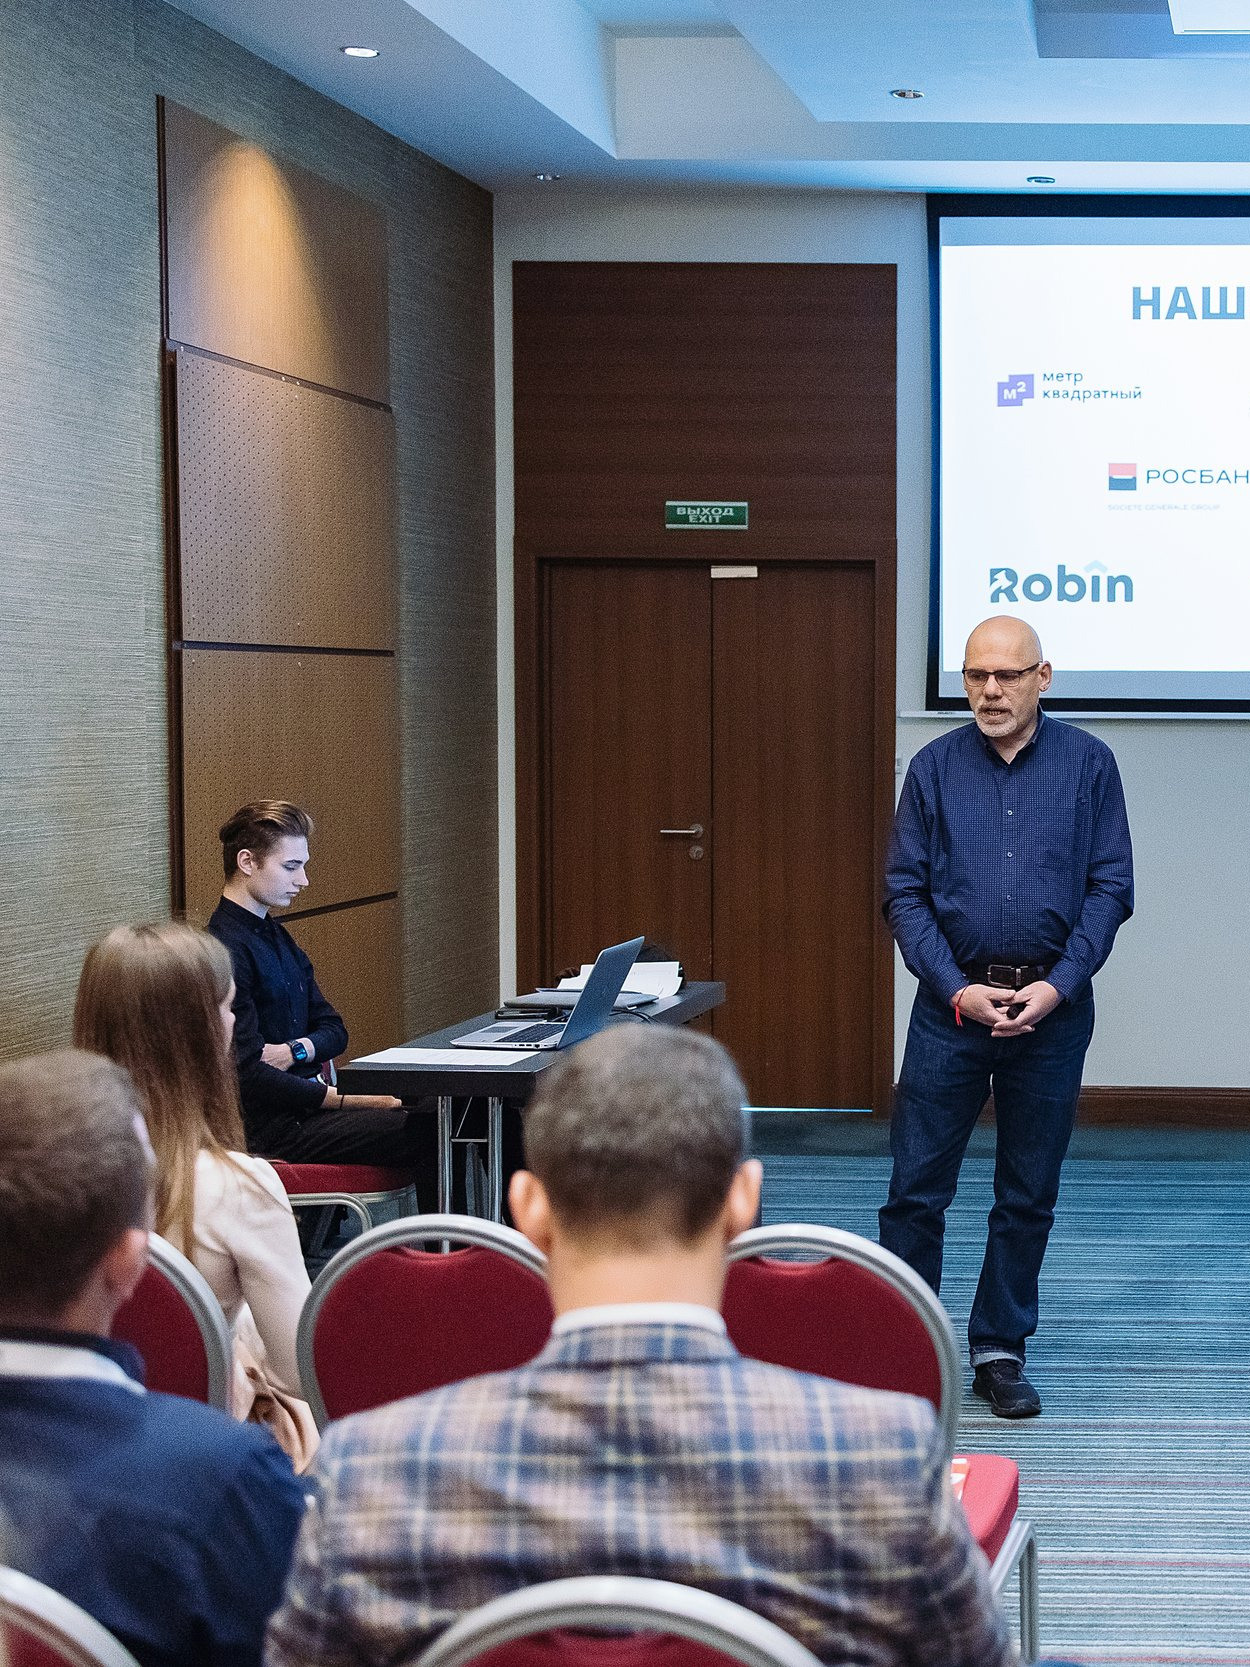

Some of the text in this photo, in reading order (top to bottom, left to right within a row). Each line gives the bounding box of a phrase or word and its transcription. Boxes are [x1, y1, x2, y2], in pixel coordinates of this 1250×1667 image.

[1043, 372, 1083, 385] метр
[1043, 387, 1142, 402] квадратный
[676, 507, 734, 516] ВЫХОД
[688, 515, 721, 523] EXIT
[990, 560, 1134, 603] Robin
